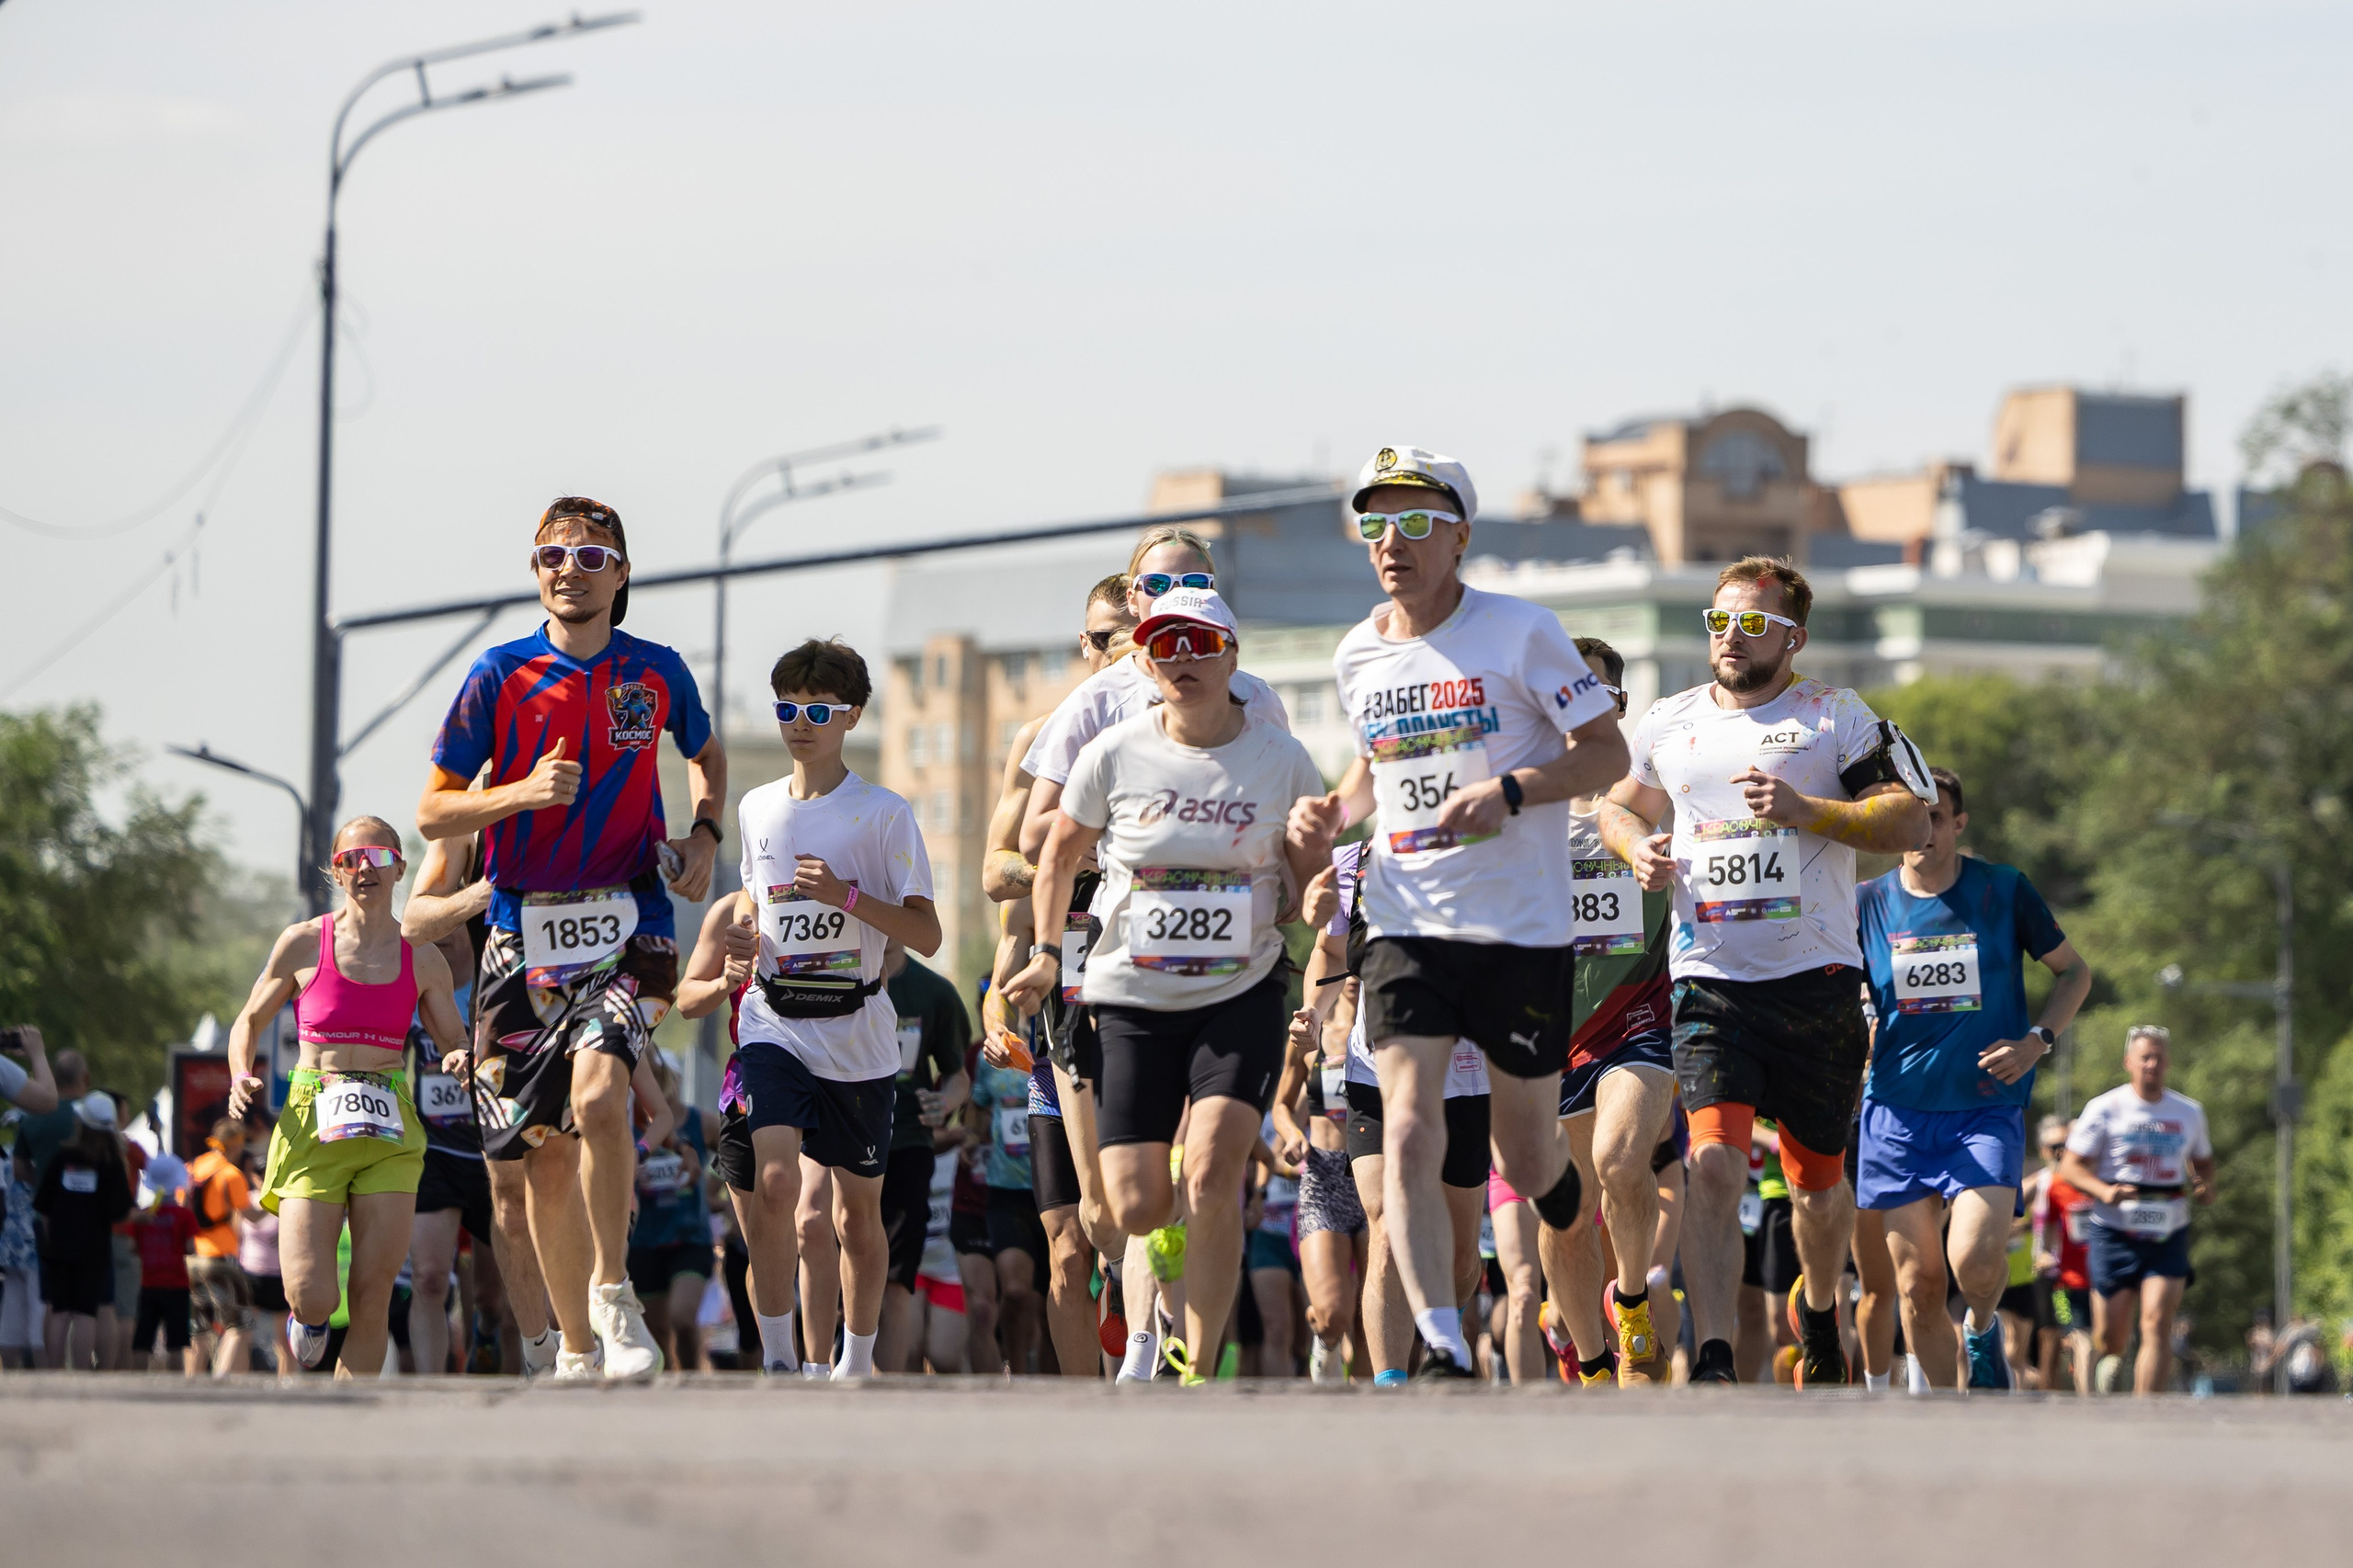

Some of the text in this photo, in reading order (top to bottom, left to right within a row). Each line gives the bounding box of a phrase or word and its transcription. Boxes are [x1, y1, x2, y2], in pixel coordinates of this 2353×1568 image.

[614, 730, 653, 742] КОСМОС
[1400, 771, 1462, 812] 356
[1708, 851, 1785, 886] 5814
[541, 915, 620, 950] 1853
[779, 911, 846, 943] 7369
[1147, 907, 1233, 941] 3282
[1906, 961, 1967, 988] 6283
[794, 993, 845, 1003] DEMIX
[310, 1029, 360, 1039] ARMOUR
[328, 1092, 391, 1119] 7800
[430, 1084, 467, 1107] 367
